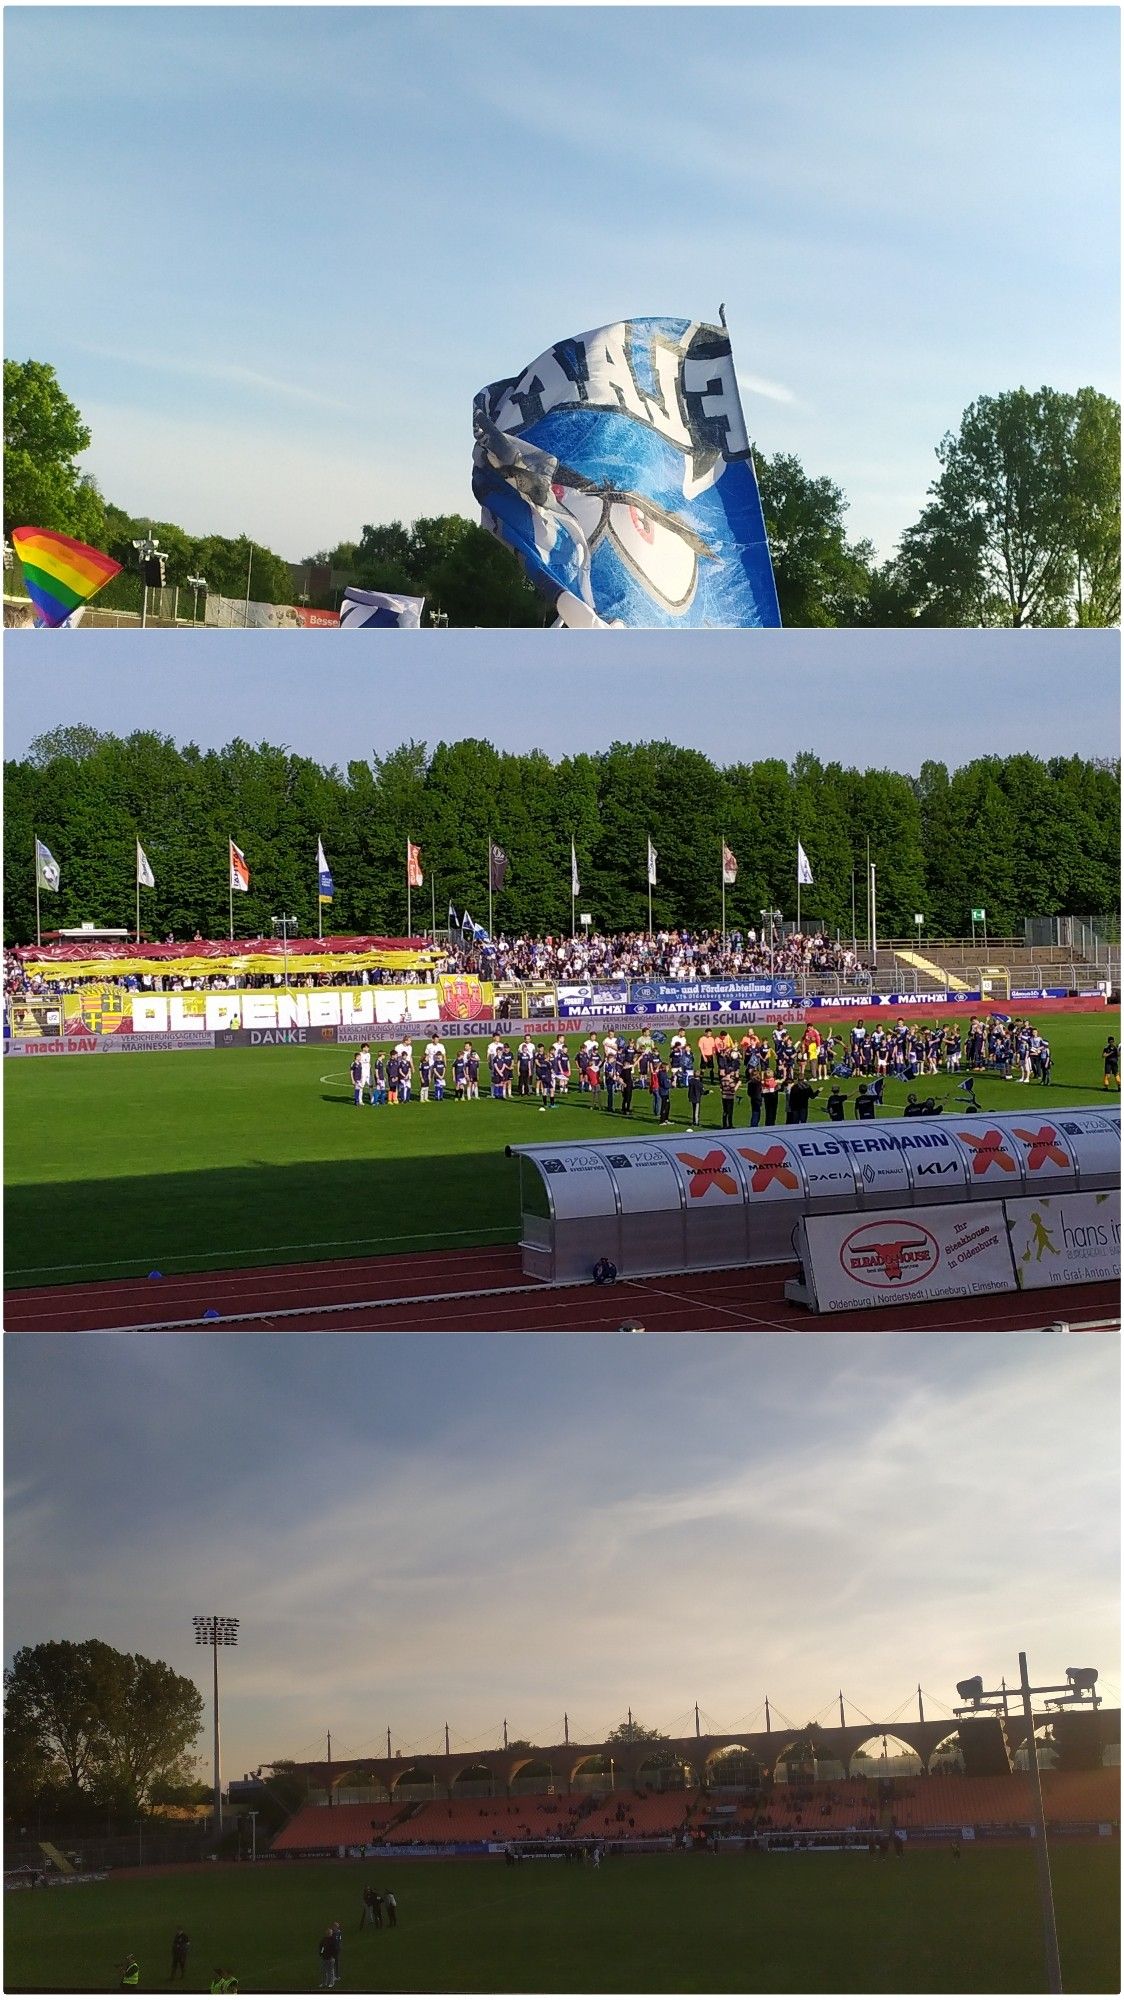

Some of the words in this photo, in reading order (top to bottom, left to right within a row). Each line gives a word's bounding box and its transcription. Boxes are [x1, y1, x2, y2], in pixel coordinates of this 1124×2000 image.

[310, 615, 340, 628] Besse
[659, 985, 679, 996] Fan-
[681, 983, 699, 994] und
[700, 981, 772, 993] FörderAbteilung
[656, 1002, 711, 1013] MATTHÄI
[740, 998, 793, 1010] MATTHÄI
[821, 996, 872, 1007] MATTHÄI
[898, 993, 947, 1004] MATTHÄI
[132, 988, 441, 1032] OLDENBURG
[568, 1005, 626, 1016] MATTHÄI
[693, 1014, 711, 1026] SEI
[712, 1012, 756, 1025] SCHLAU
[766, 1011, 794, 1023] mach
[441, 1024, 462, 1036] SEI
[463, 1021, 512, 1035] SCHLAU
[523, 1020, 556, 1033] mach
[557, 1018, 582, 1032] bAV
[602, 1022, 643, 1031] MARINESSE
[121, 1031, 212, 1042] VERSICHERUNGSAGENTUR
[250, 1028, 307, 1045] DANKE
[338, 1033, 385, 1042] MARINESSE
[25, 1039, 64, 1054] mach
[68, 1037, 98, 1052] bAV
[121, 1042, 173, 1051] MARINESSE
[799, 1133, 950, 1157] ELSTERMANN
[686, 1165, 731, 1176] MATTHÄI
[748, 1160, 793, 1171] MATTHÄI
[877, 1167, 904, 1176] RENAULT
[809, 1172, 853, 1182] DACIA
[953, 1220, 968, 1235] Ihr
[1060, 1210, 1108, 1249] hans
[945, 1225, 990, 1255] Steakhouse
[947, 1259, 957, 1270] in
[957, 1234, 1000, 1265] Oldenburg
[828, 1297, 871, 1310] Oldenburg
[877, 1291, 924, 1304] Norderstedt
[929, 1286, 967, 1299] Lüneburg
[972, 1280, 1009, 1292] Elmshorn
